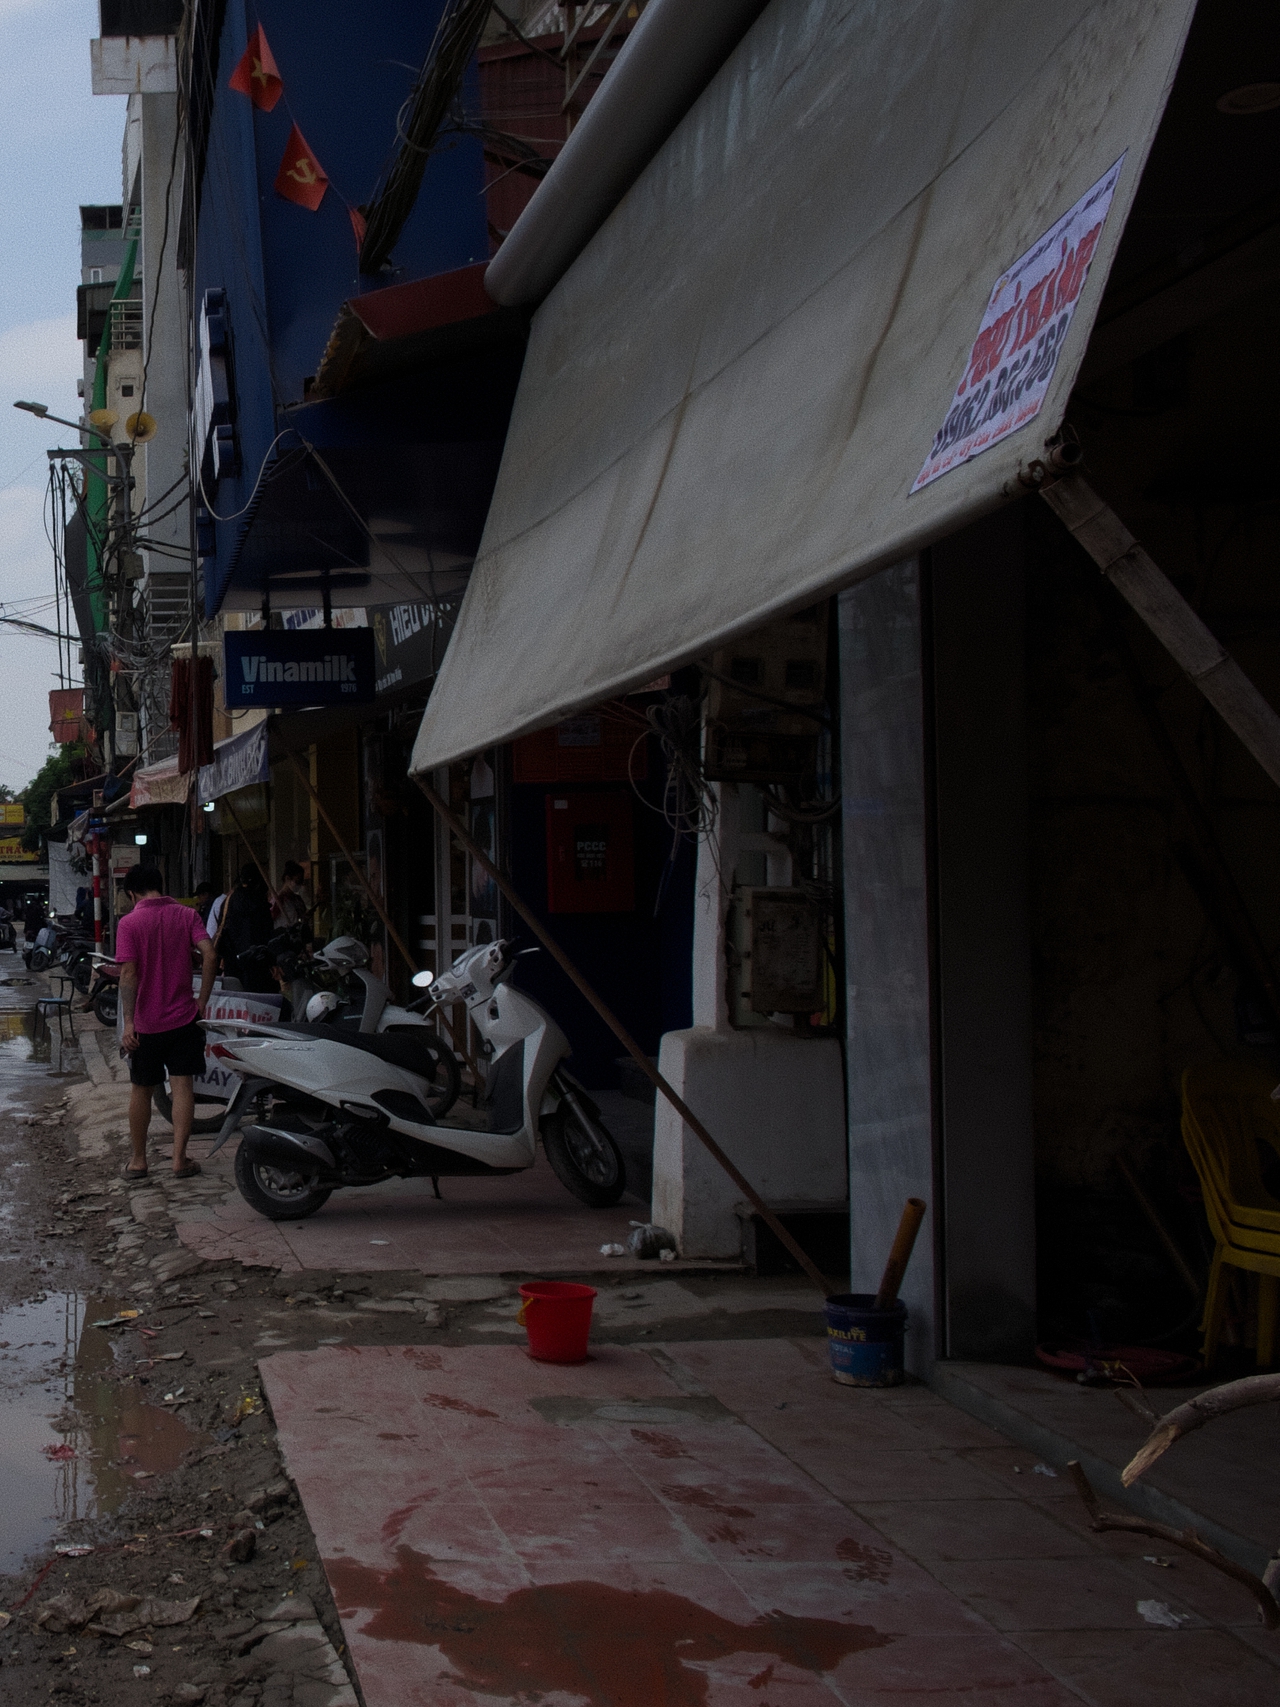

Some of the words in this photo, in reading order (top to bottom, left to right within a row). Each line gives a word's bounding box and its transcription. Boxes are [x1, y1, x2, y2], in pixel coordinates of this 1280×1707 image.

[240, 654, 356, 683] Vinamilk
[241, 684, 254, 694] EST
[340, 683, 357, 693] 1976
[576, 841, 607, 851] PCCC
